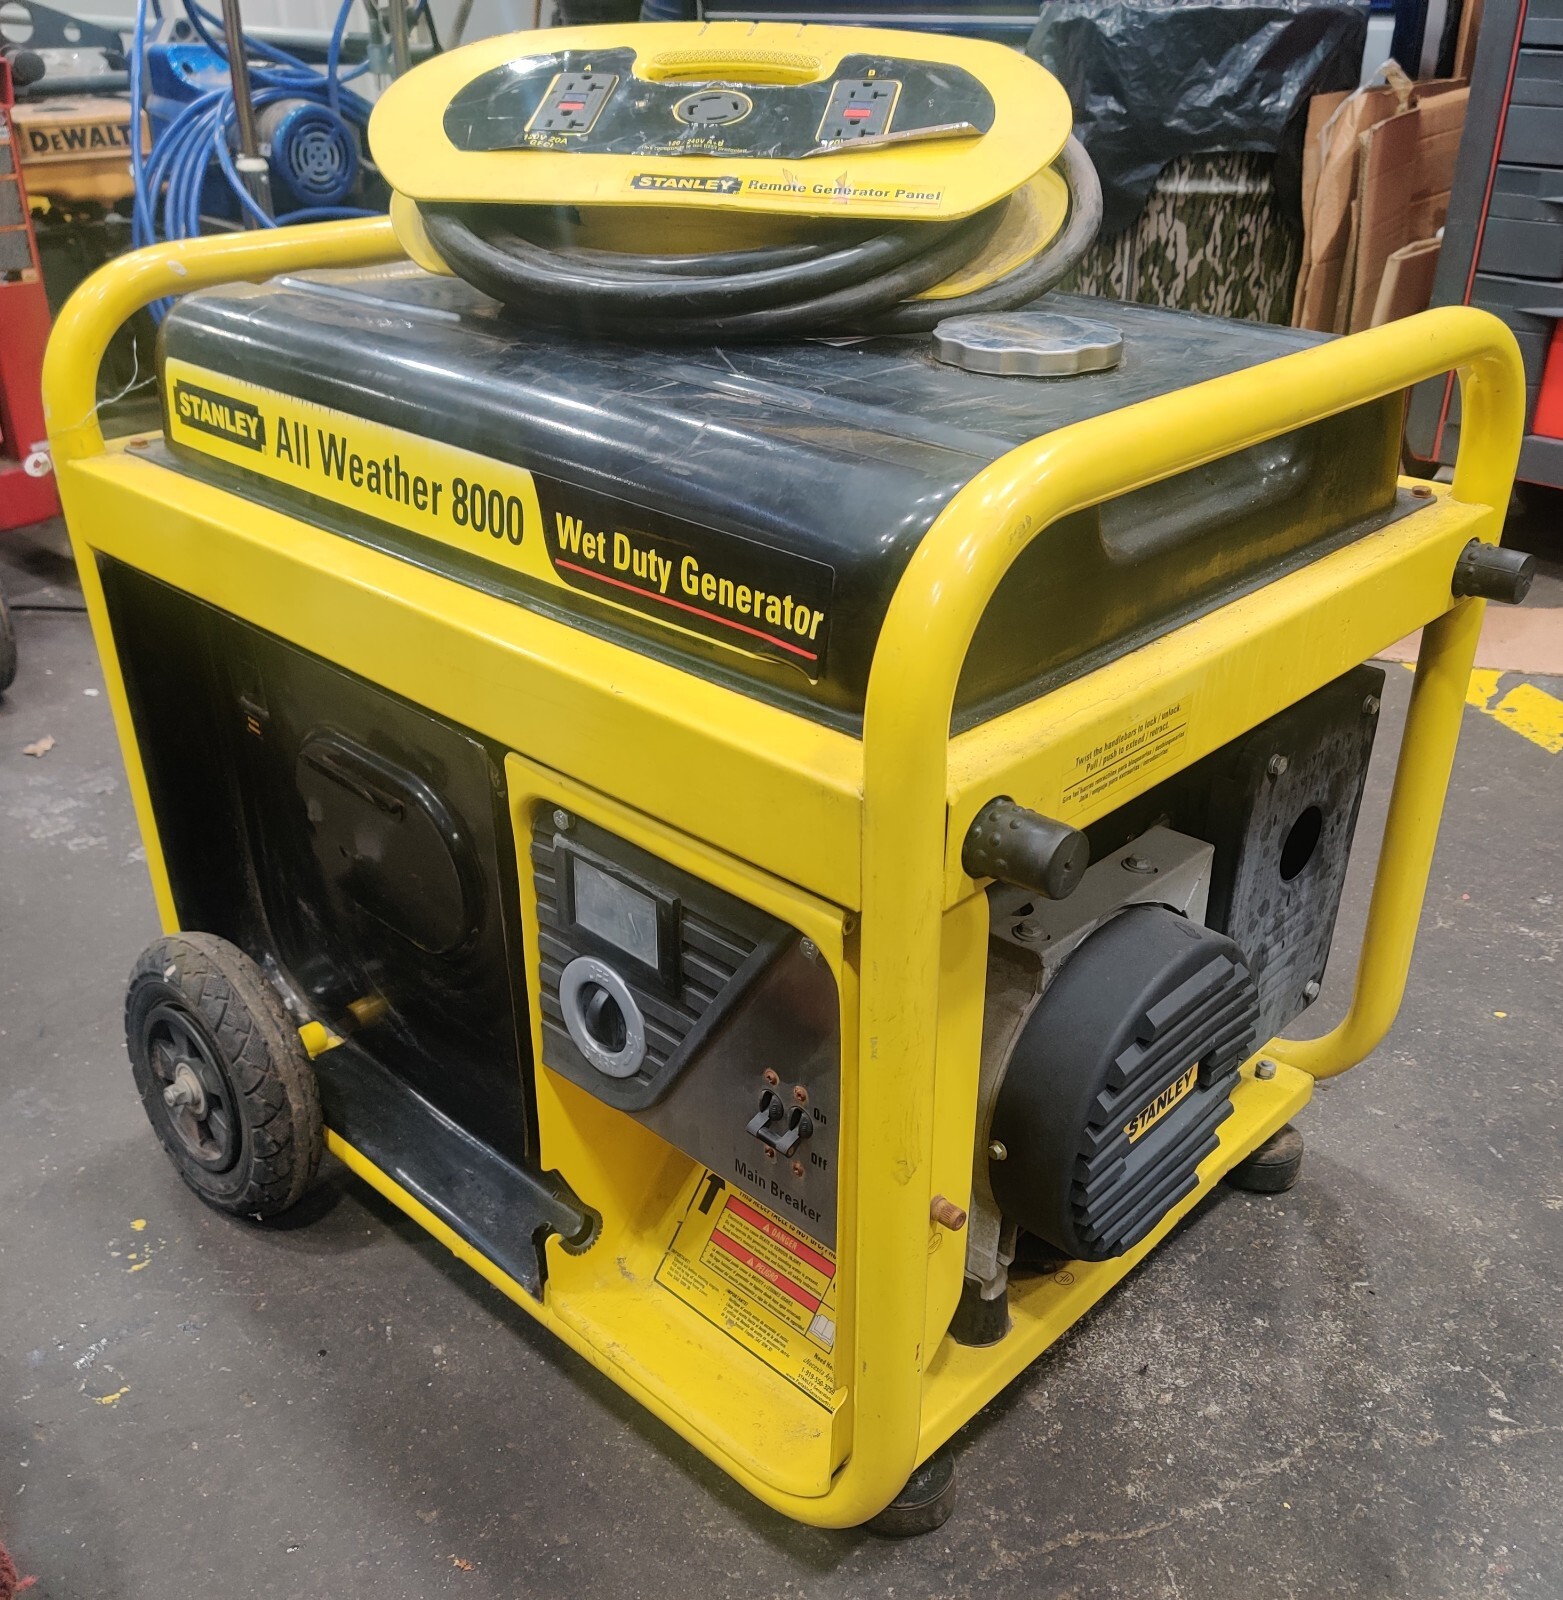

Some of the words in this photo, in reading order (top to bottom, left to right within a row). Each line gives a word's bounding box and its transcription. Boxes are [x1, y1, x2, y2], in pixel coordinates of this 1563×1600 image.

[638, 176, 735, 191] STANLEY
[748, 179, 806, 193] Remote
[812, 183, 891, 198] Generator
[895, 188, 941, 201] Panel
[179, 391, 259, 440] STANLEY
[276, 416, 310, 470] All
[318, 429, 443, 516] Weather
[452, 477, 524, 546] 8000
[555, 511, 606, 564] Wet
[613, 531, 672, 594] Duty
[680, 555, 824, 641] Generator
[1075, 755, 1092, 768] Twist
[1093, 747, 1102, 758] the
[1104, 727, 1136, 751] handlebars
[1138, 723, 1143, 733] to
[1145, 717, 1156, 729] lock
[1086, 761, 1098, 773] Pull
[1103, 749, 1117, 766] push
[1119, 745, 1124, 754] to
[1126, 736, 1145, 750] extend
[1128, 1067, 1194, 1138] STANLEY
[813, 1107, 827, 1125] On
[811, 1152, 828, 1171] Off
[735, 1158, 766, 1190] Main
[770, 1180, 822, 1224] Breaker
[772, 1228, 798, 1250] DANGER
[755, 1262, 779, 1283] PELIGRO
[814, 1353, 826, 1365] Need
[825, 1373, 834, 1384] Ayu
